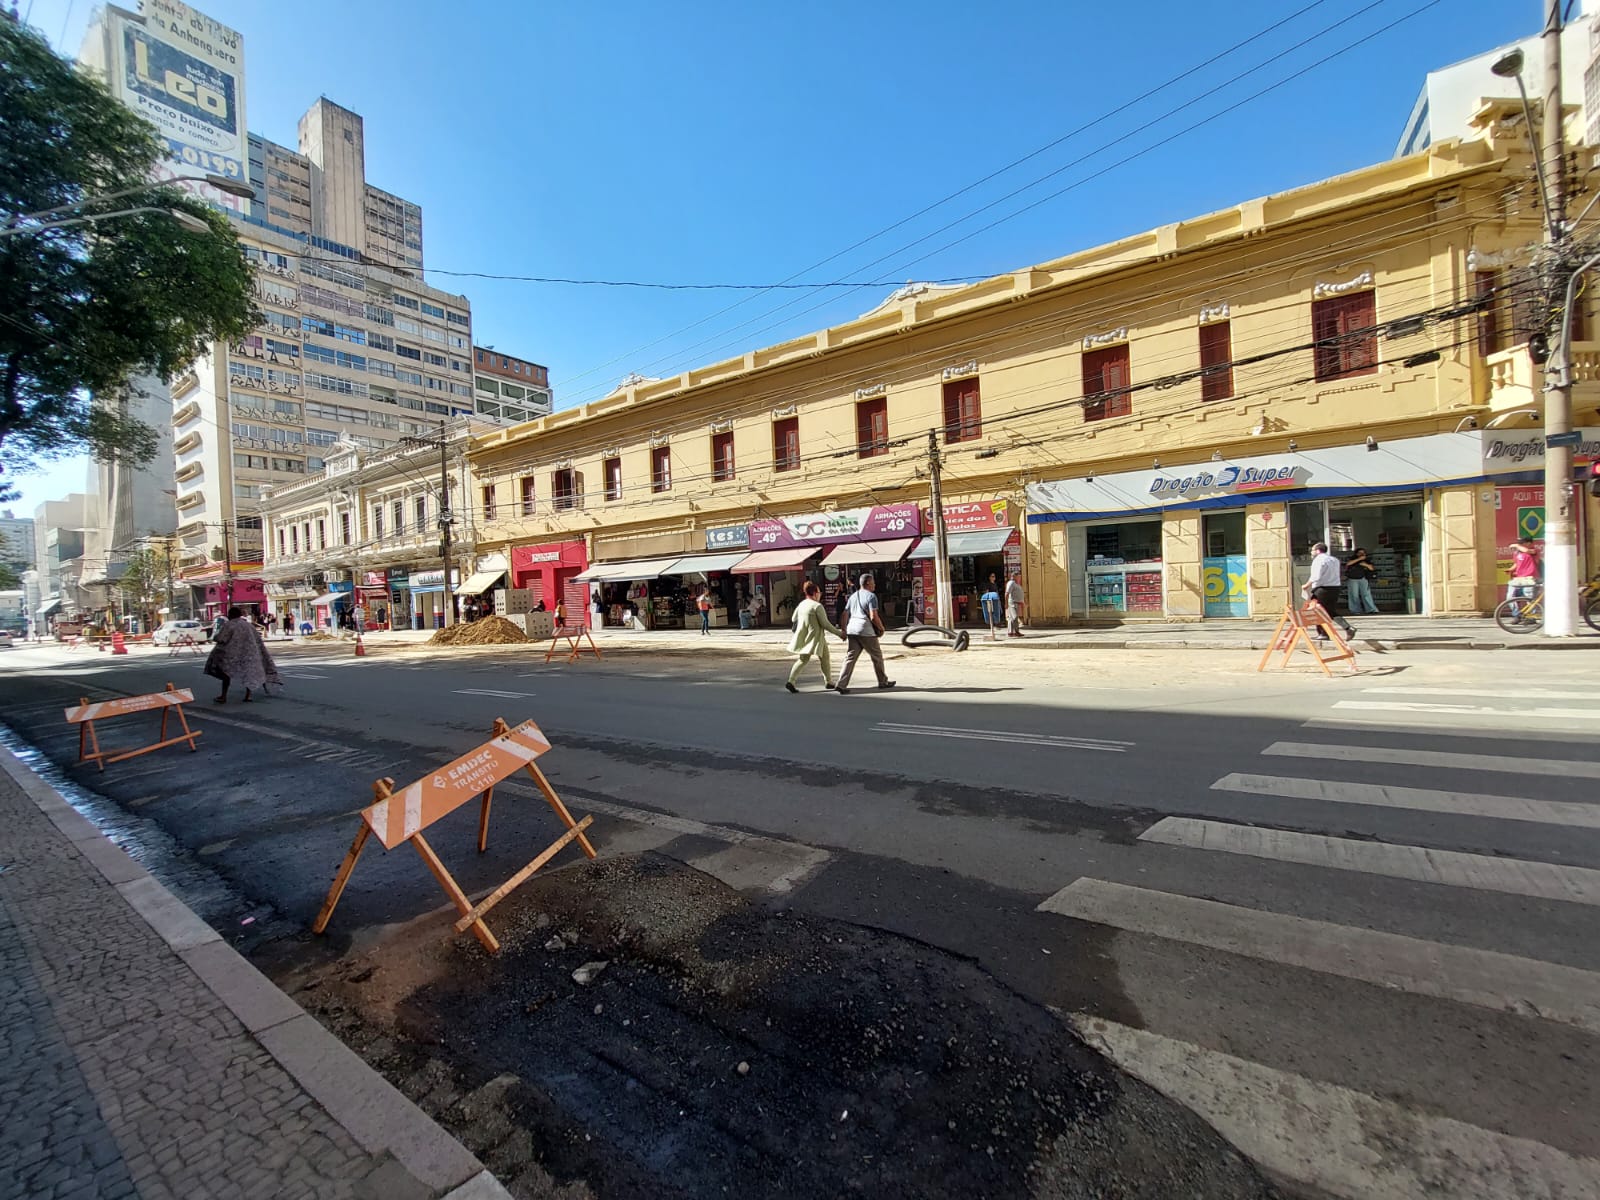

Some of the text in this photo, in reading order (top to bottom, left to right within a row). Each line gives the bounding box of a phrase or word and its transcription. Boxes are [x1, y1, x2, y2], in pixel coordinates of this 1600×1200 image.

[1149, 465, 1297, 494] Drogão Super
[1513, 491, 1531, 501] AQUI
[874, 510, 912, 520] ARMAÇÕES
[448, 749, 492, 780] EMDEC
[478, 775, 496, 787] 118
